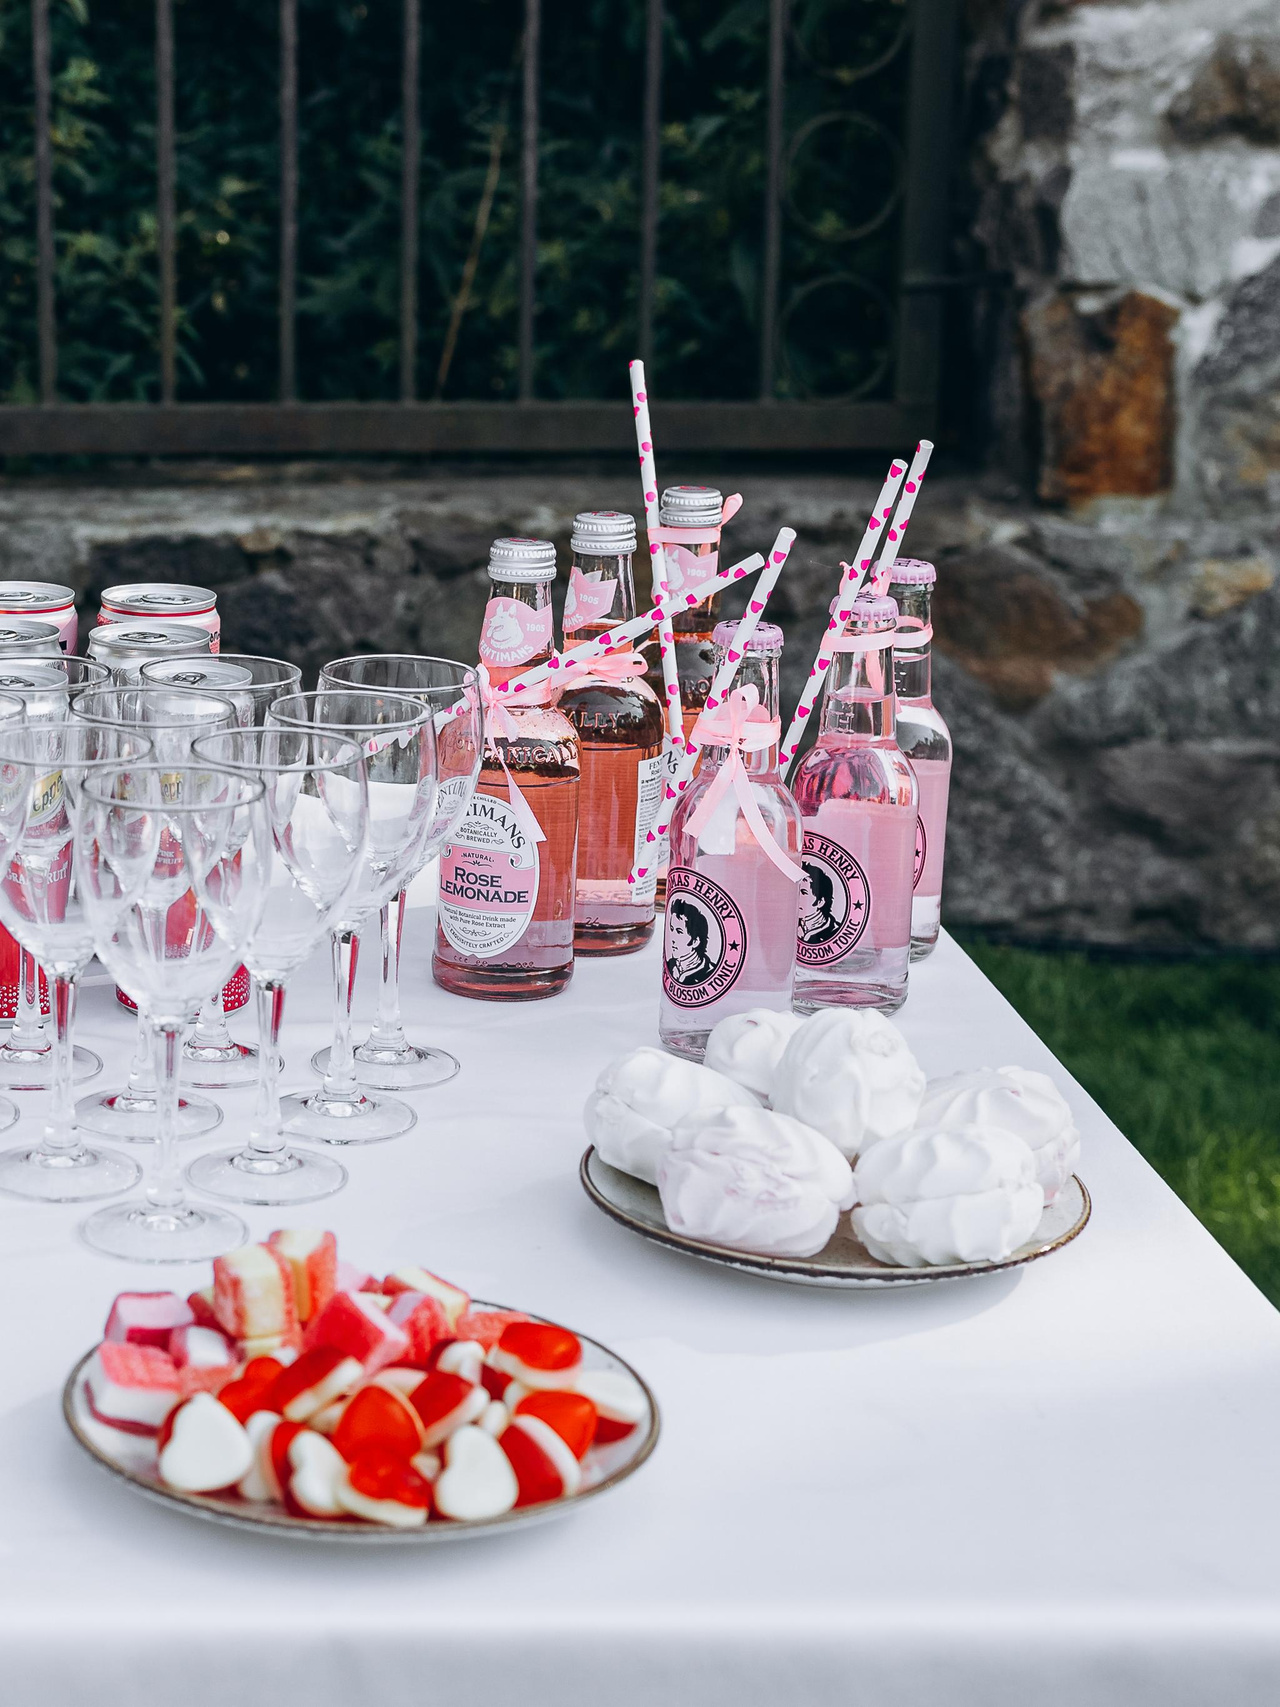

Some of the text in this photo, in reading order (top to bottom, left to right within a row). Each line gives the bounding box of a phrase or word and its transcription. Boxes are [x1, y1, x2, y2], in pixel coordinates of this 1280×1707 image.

[687, 567, 707, 578] 1905
[579, 593, 599, 605] 1905
[526, 623, 545, 633] 1905
[480, 640, 534, 663] FENTIMANS
[460, 827, 497, 838] BOTANICALLY
[466, 834, 491, 845] BREWED
[820, 842, 859, 882] HENRY
[454, 866, 502, 888] ROSE
[440, 874, 529, 904] LEMONADE
[693, 878, 735, 921] HENRY
[449, 914, 459, 922] with
[459, 917, 471, 926] Pure
[472, 919, 484, 928] Rose
[458, 910, 481, 921] Botanical
[482, 914, 499, 923] Drink
[450, 928, 504, 949] EXQUISITELY CRAFTED
[797, 918, 861, 959] LOSSOM TONIC
[669, 960, 737, 1002] BLOSSOM TONIC
